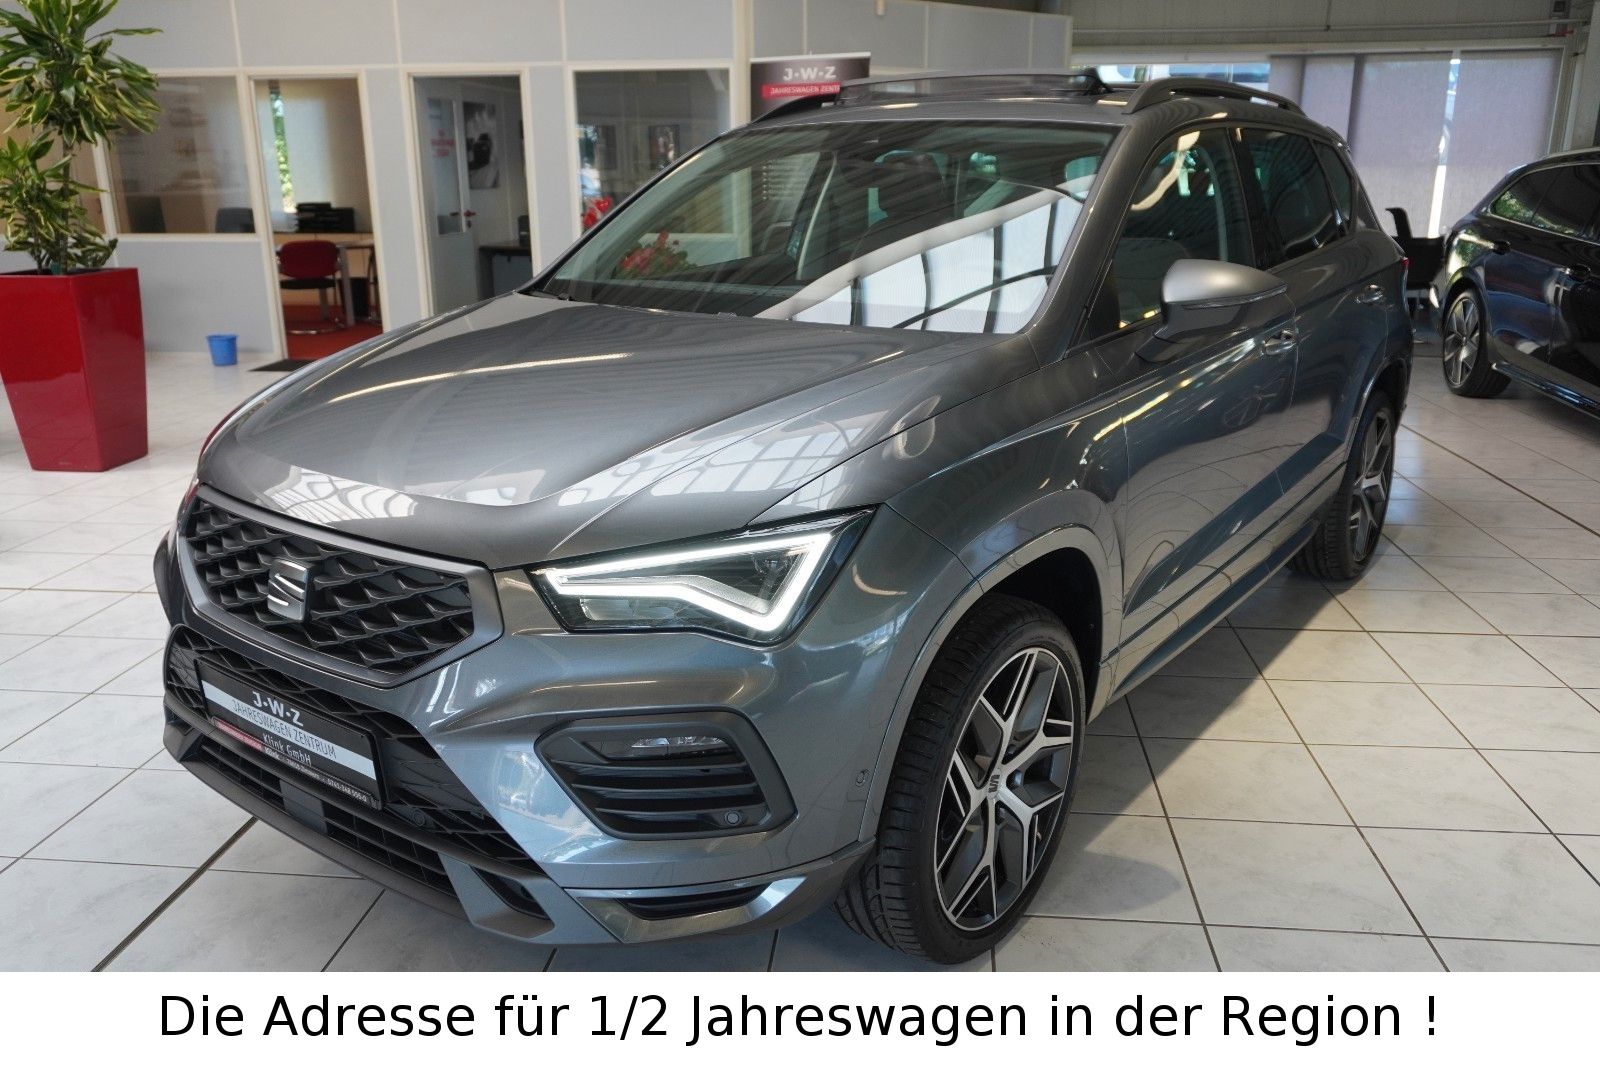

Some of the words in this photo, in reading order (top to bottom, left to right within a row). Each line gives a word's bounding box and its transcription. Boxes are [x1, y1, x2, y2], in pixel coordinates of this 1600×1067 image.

[770, 86, 819, 95] JAHRESWAGEN
[232, 699, 292, 739] JAHRESWAGEN
[293, 728, 337, 760] ZENTRUM
[286, 744, 312, 767] GmbH
